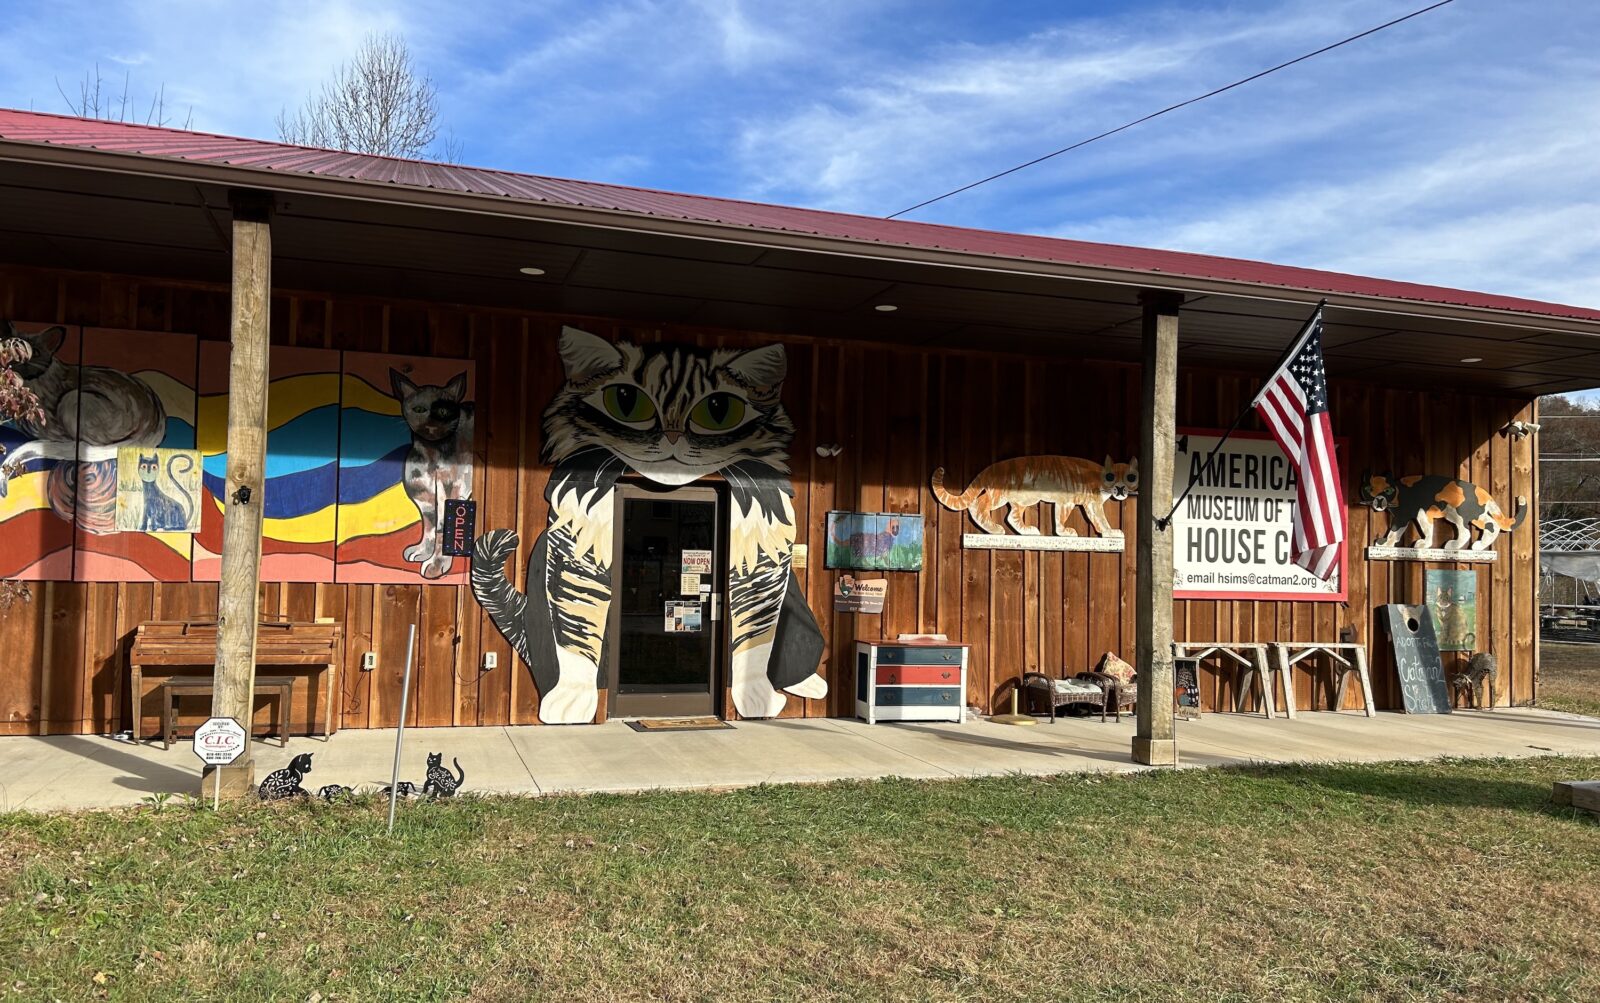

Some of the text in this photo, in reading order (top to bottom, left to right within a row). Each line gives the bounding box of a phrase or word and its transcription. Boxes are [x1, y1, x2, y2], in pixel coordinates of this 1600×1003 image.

[1188, 451, 1297, 491] AMERICA
[1187, 494, 1259, 523] MUSEUM
[1264, 497, 1283, 523] OF
[455, 506, 467, 551] OPEN
[1187, 526, 1266, 565] HOUSE
[683, 557, 711, 566] NOW OPEN
[855, 584, 883, 592] Welcome
[1187, 572, 1317, 588] email hsims@catman2.org
[204, 735, 236, 745] C.I.C.
